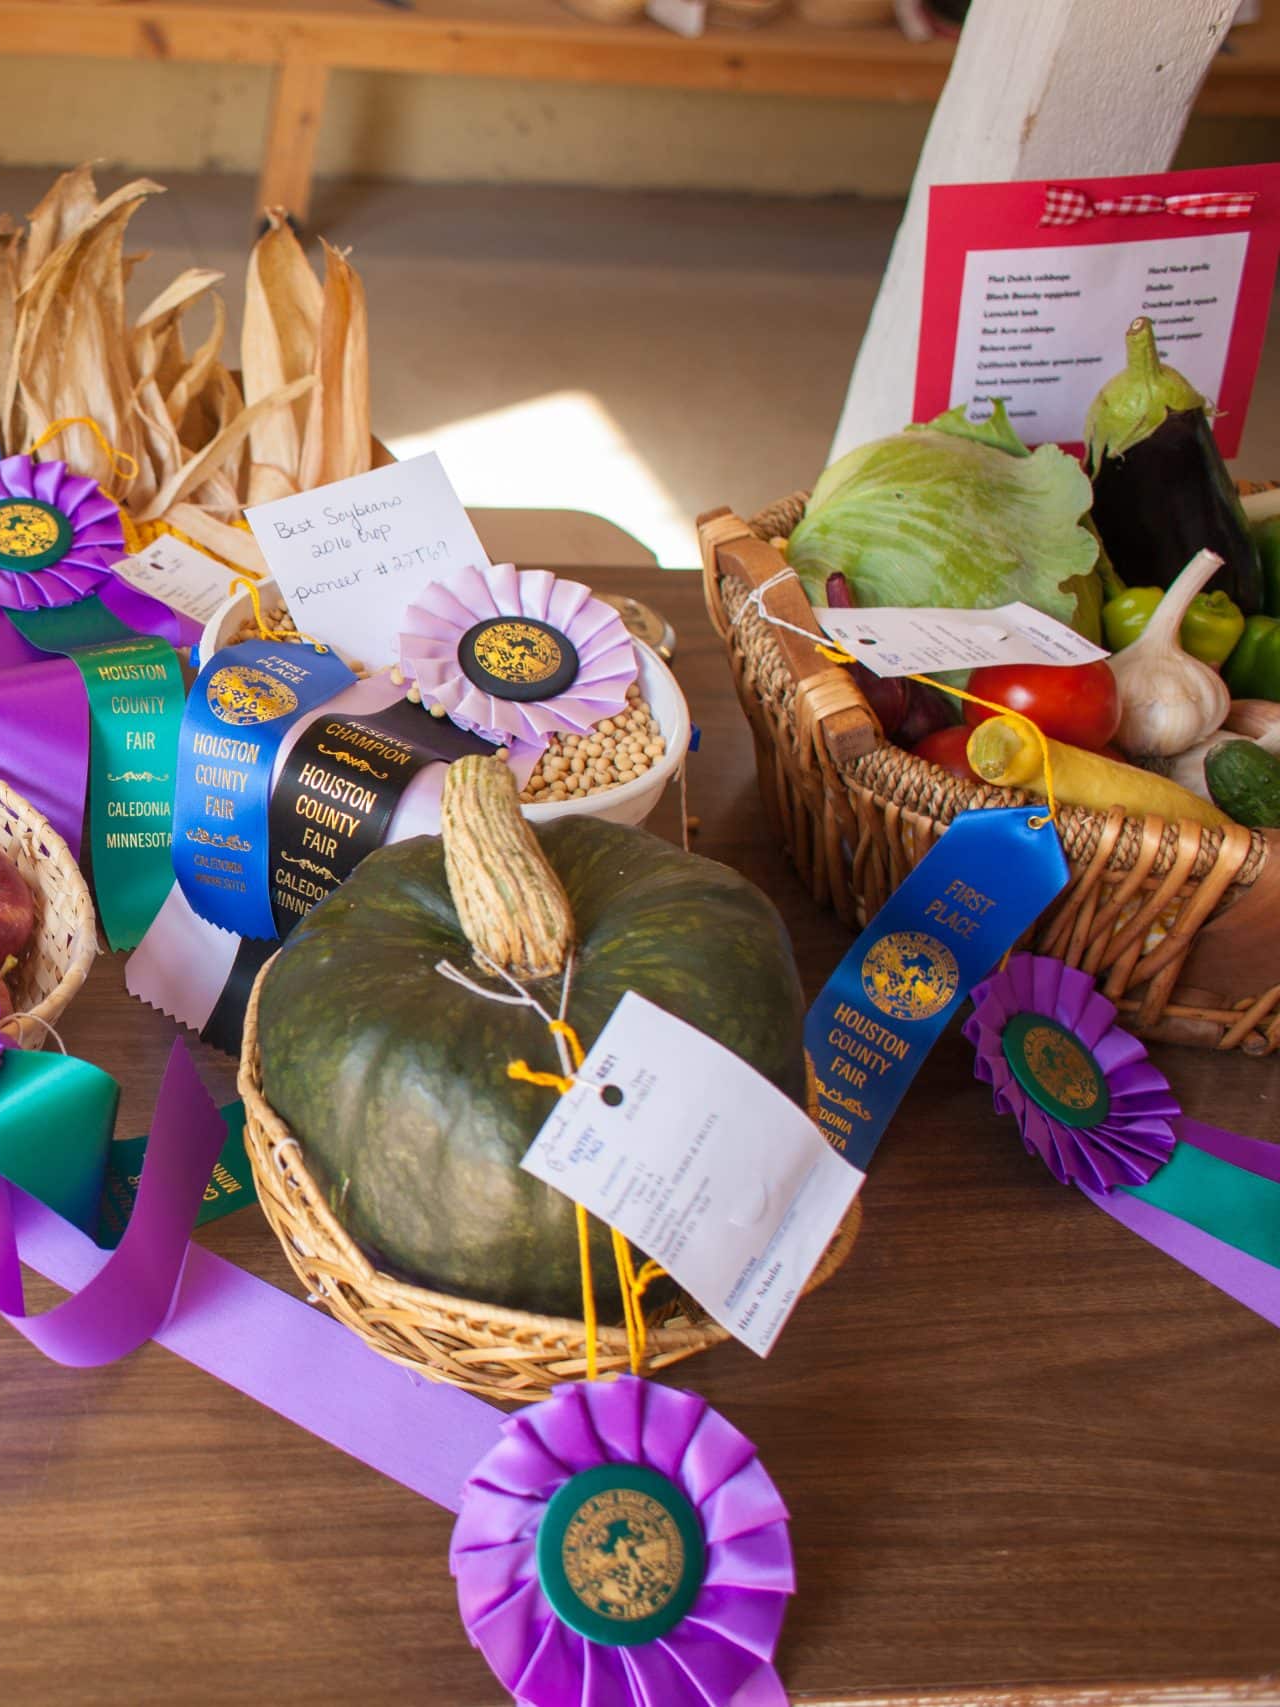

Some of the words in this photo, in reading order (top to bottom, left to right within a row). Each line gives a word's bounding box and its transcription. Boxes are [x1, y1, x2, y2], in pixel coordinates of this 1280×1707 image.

[273, 519, 316, 539] Best
[323, 496, 402, 531] Soybeans
[312, 536, 352, 558] 2016
[98, 664, 167, 681] HOUSTON
[256, 658, 305, 684] PLACE
[267, 655, 312, 677] FIRST
[111, 696, 165, 715] COUNTY
[126, 732, 157, 750] FAIR
[193, 732, 261, 765] HOUSTON
[325, 722, 412, 766] CHAMPION
[346, 721, 416, 753] RESERVE
[195, 764, 249, 793] COUNTY
[298, 763, 378, 814] HOUSTON
[107, 801, 171, 818] CALEDONIA
[205, 795, 235, 820] FAIR
[296, 794, 361, 838] COUNTY
[106, 832, 173, 849] MINNESOTA
[302, 828, 338, 859] FAIR
[193, 854, 243, 875] CALEDONIA
[195, 873, 247, 893] MINNESOTA
[275, 868, 329, 902] CALEDO
[944, 879, 997, 916] FIRST
[924, 899, 981, 940] PLACE
[833, 1003, 910, 1060] HOUSTON
[828, 1028, 893, 1076] COUNTY
[830, 1056, 868, 1089] FAIR
[819, 1107, 853, 1135] DONIA
